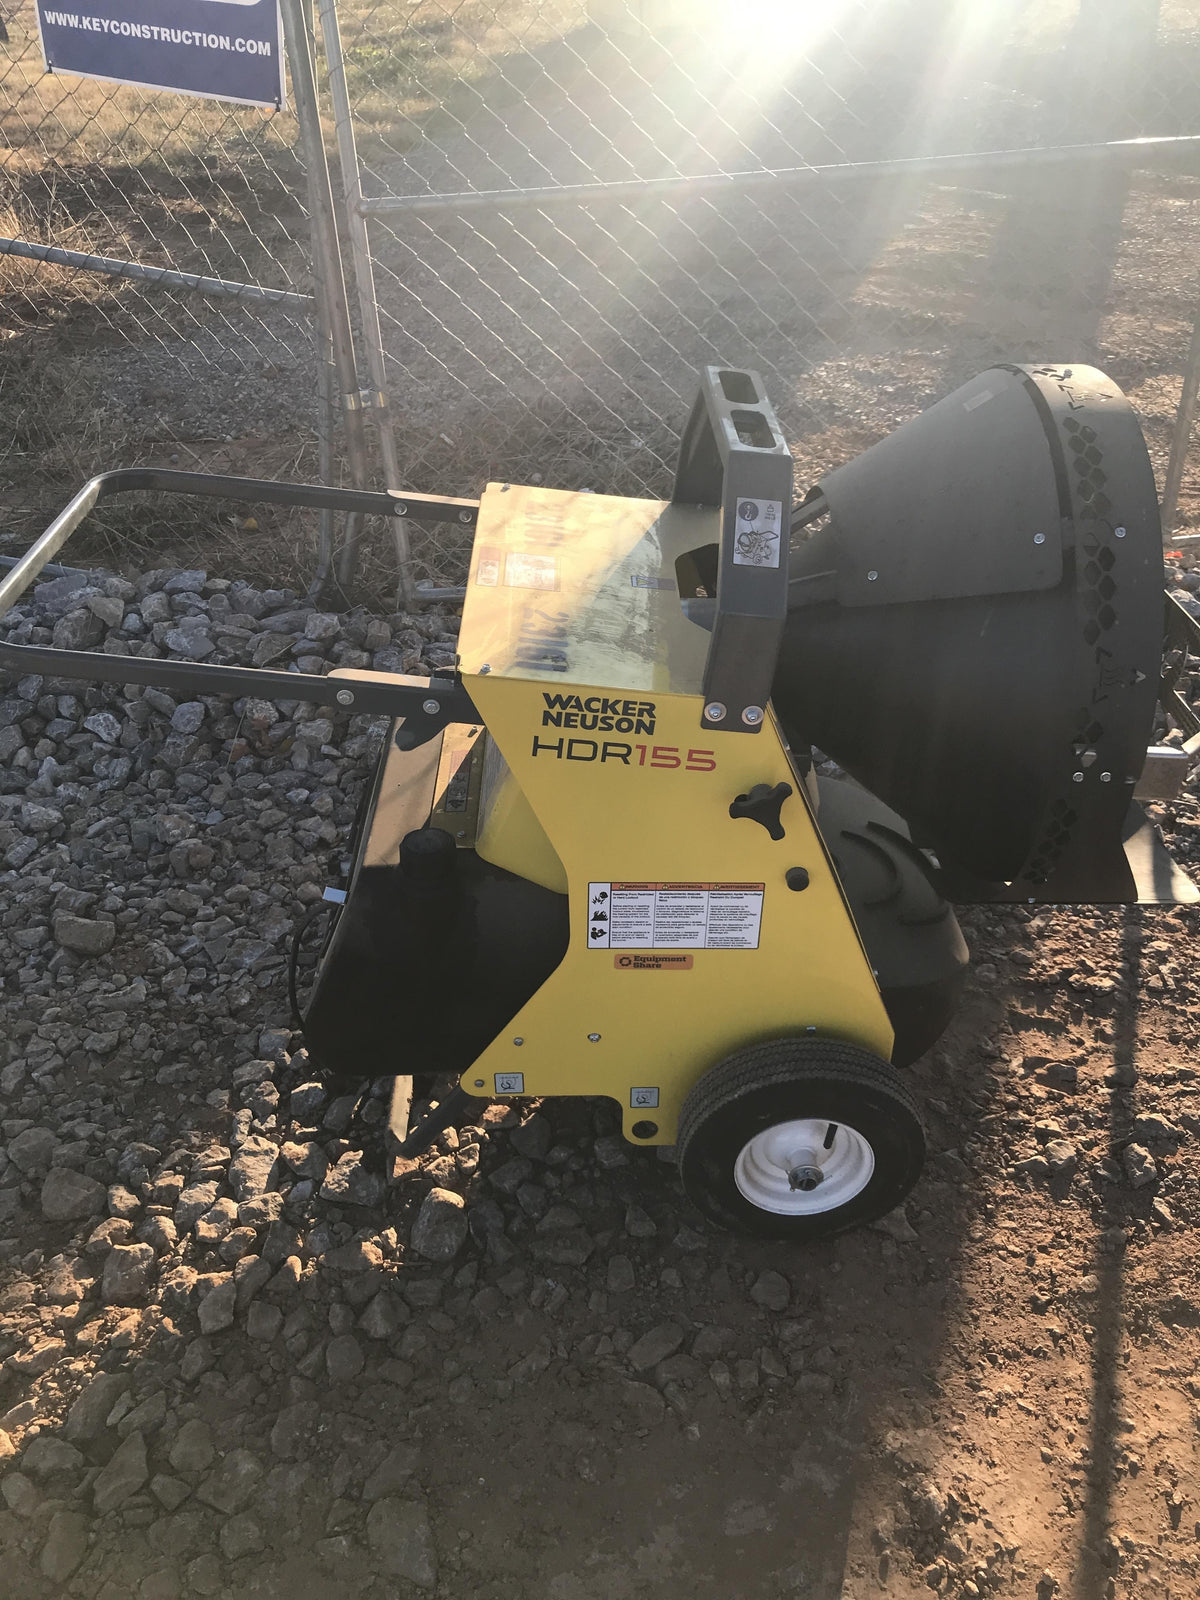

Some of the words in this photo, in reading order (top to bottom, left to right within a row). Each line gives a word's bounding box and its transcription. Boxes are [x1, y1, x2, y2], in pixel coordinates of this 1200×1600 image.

[44, 10, 271, 56] WWW.KEYCONSTRUCTION.COM
[542, 692, 656, 719] WACKER
[542, 710, 656, 735] NEUSON
[532, 735, 717, 772] HDR155
[633, 955, 687, 963] Equipment
